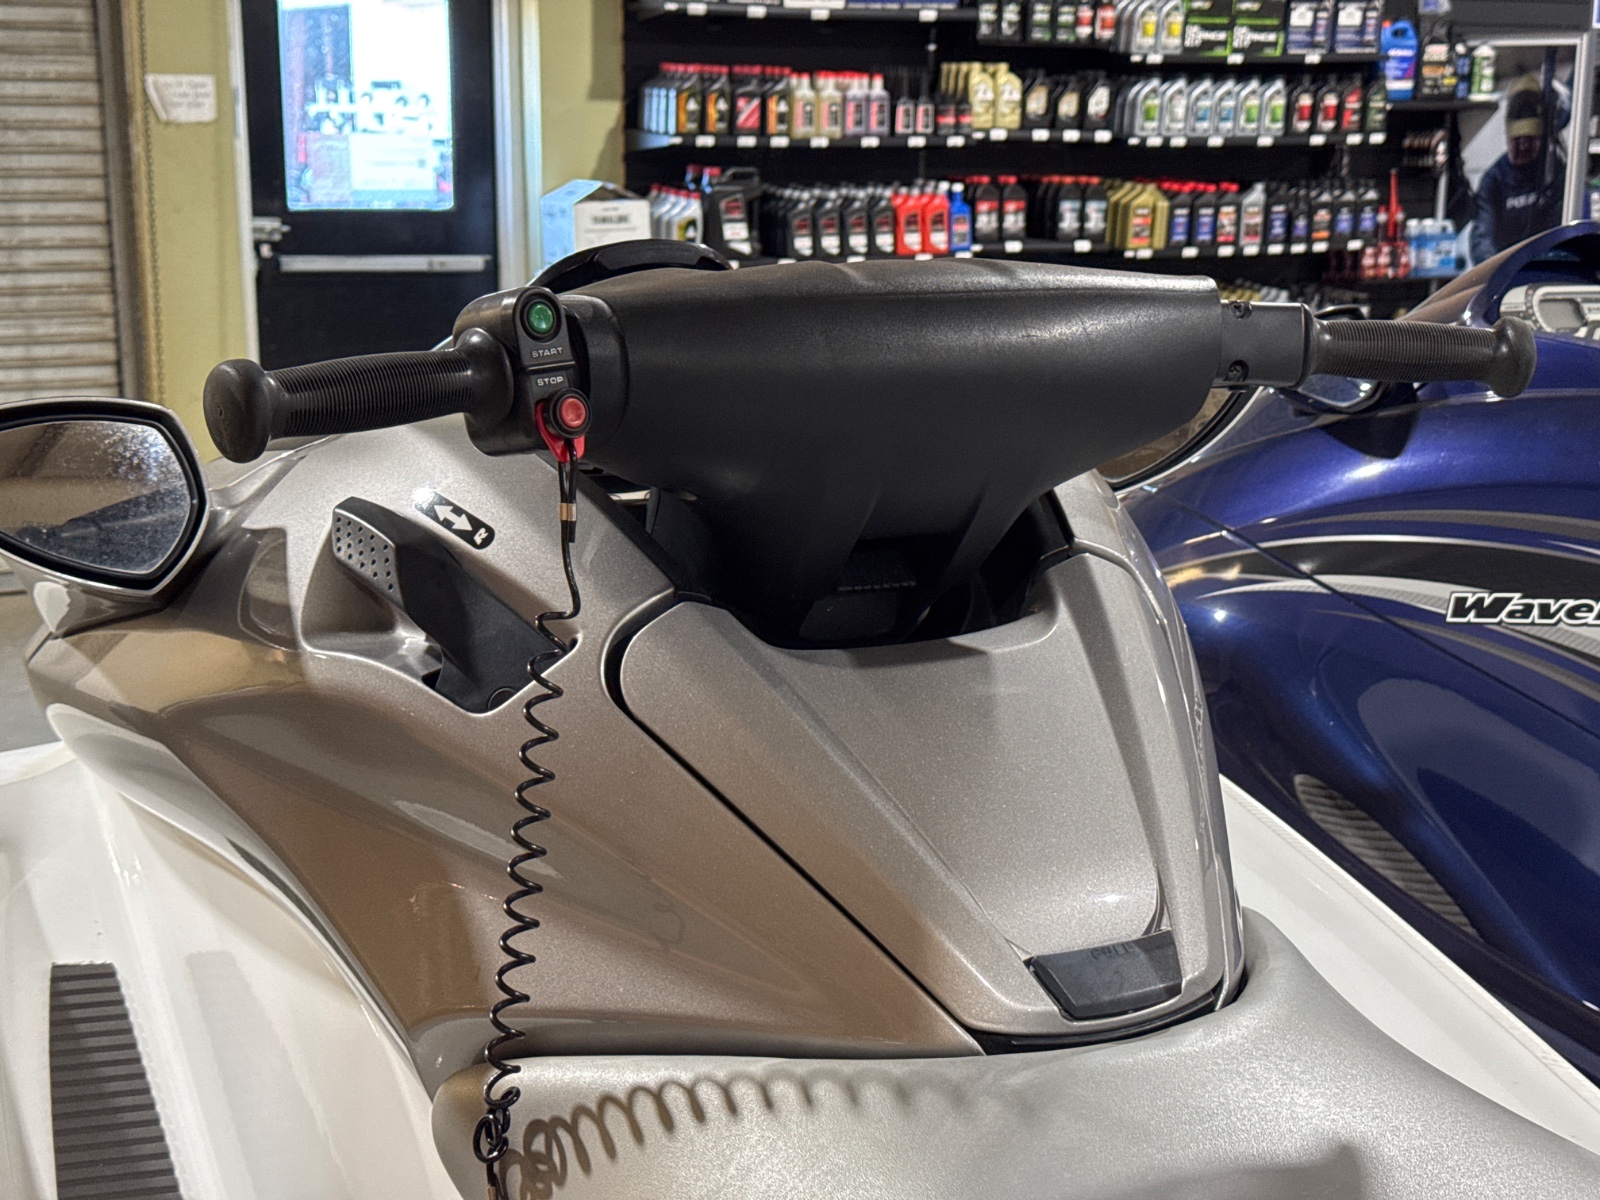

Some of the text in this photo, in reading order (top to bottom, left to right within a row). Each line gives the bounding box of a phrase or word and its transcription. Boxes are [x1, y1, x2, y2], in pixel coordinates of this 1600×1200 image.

[532, 347, 564, 358] START
[537, 376, 564, 387] STOP
[473, 527, 489, 546] R
